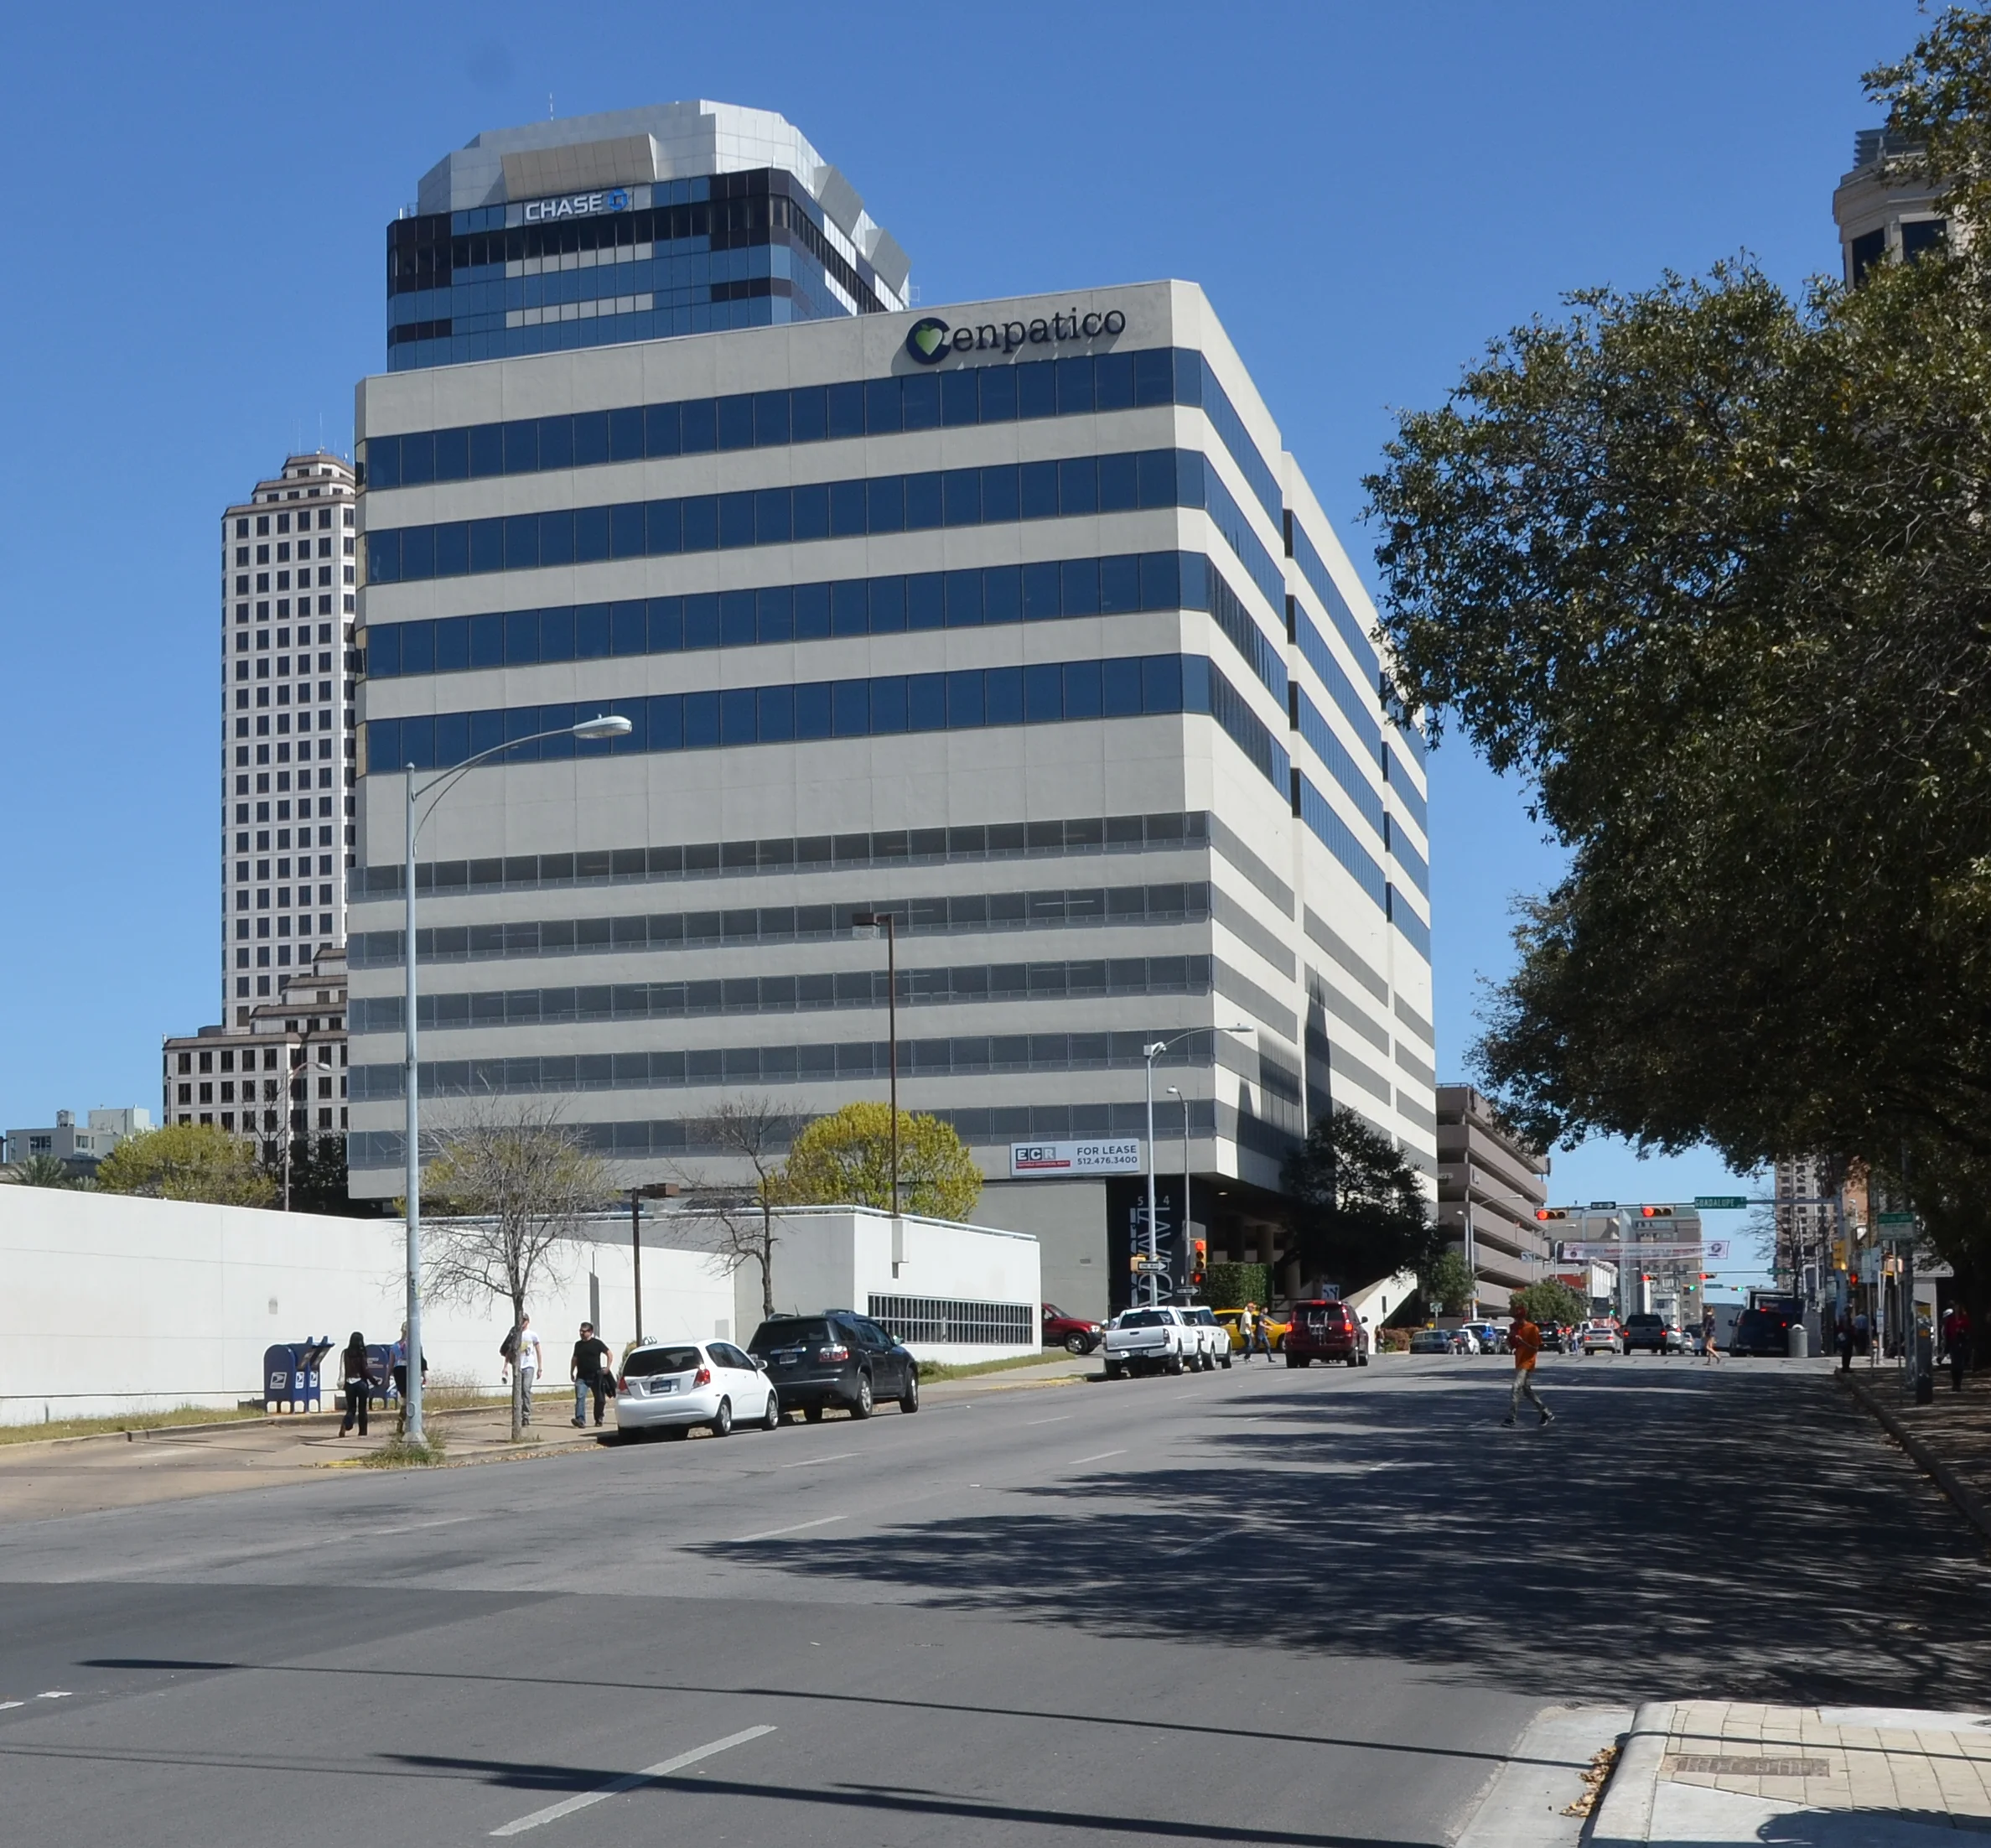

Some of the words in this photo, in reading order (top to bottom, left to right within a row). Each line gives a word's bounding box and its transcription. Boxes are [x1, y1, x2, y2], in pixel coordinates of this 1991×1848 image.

[526, 194, 603, 221] CHASE
[905, 307, 1126, 365] Cenpatico
[1017, 1149, 1055, 1160] ECR
[1076, 1147, 1099, 1156] FOR
[1102, 1145, 1137, 1155] LEASE
[1077, 1156, 1138, 1165] 512.476.3400
[1137, 1196, 1169, 1207] 54
[1695, 1198, 1734, 1207] GUADALUPE
